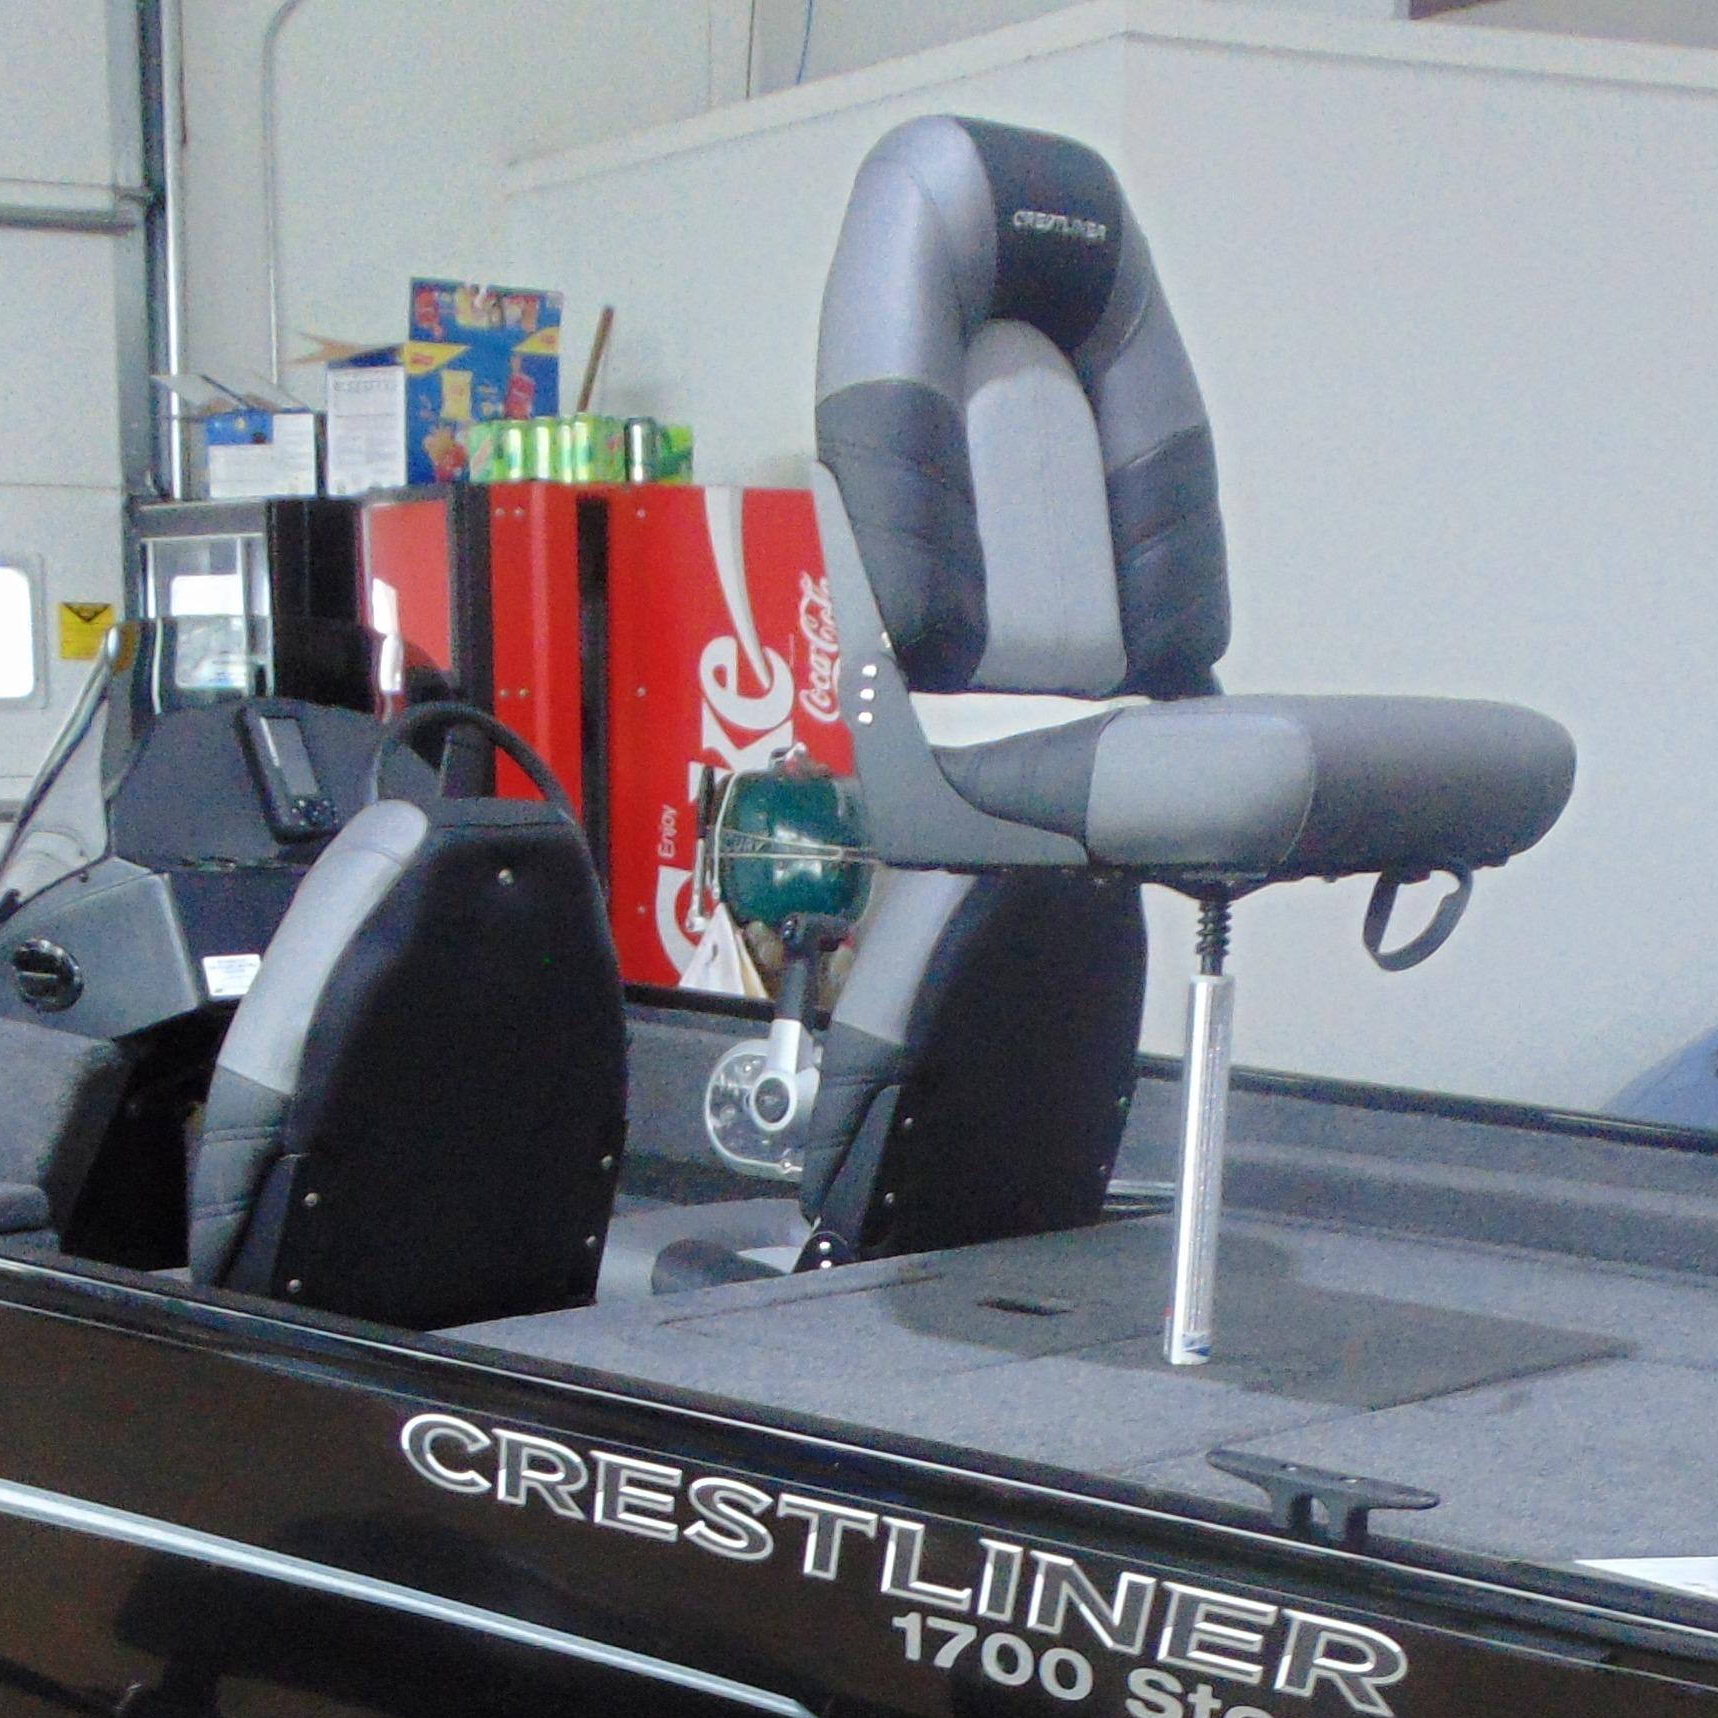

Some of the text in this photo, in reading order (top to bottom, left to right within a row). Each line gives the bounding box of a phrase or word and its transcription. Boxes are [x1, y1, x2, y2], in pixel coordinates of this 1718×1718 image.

[658, 804, 677, 859] Enjoy
[399, 1413, 1411, 1718] CRESTLINER
[892, 1611, 1093, 1702] 1700
